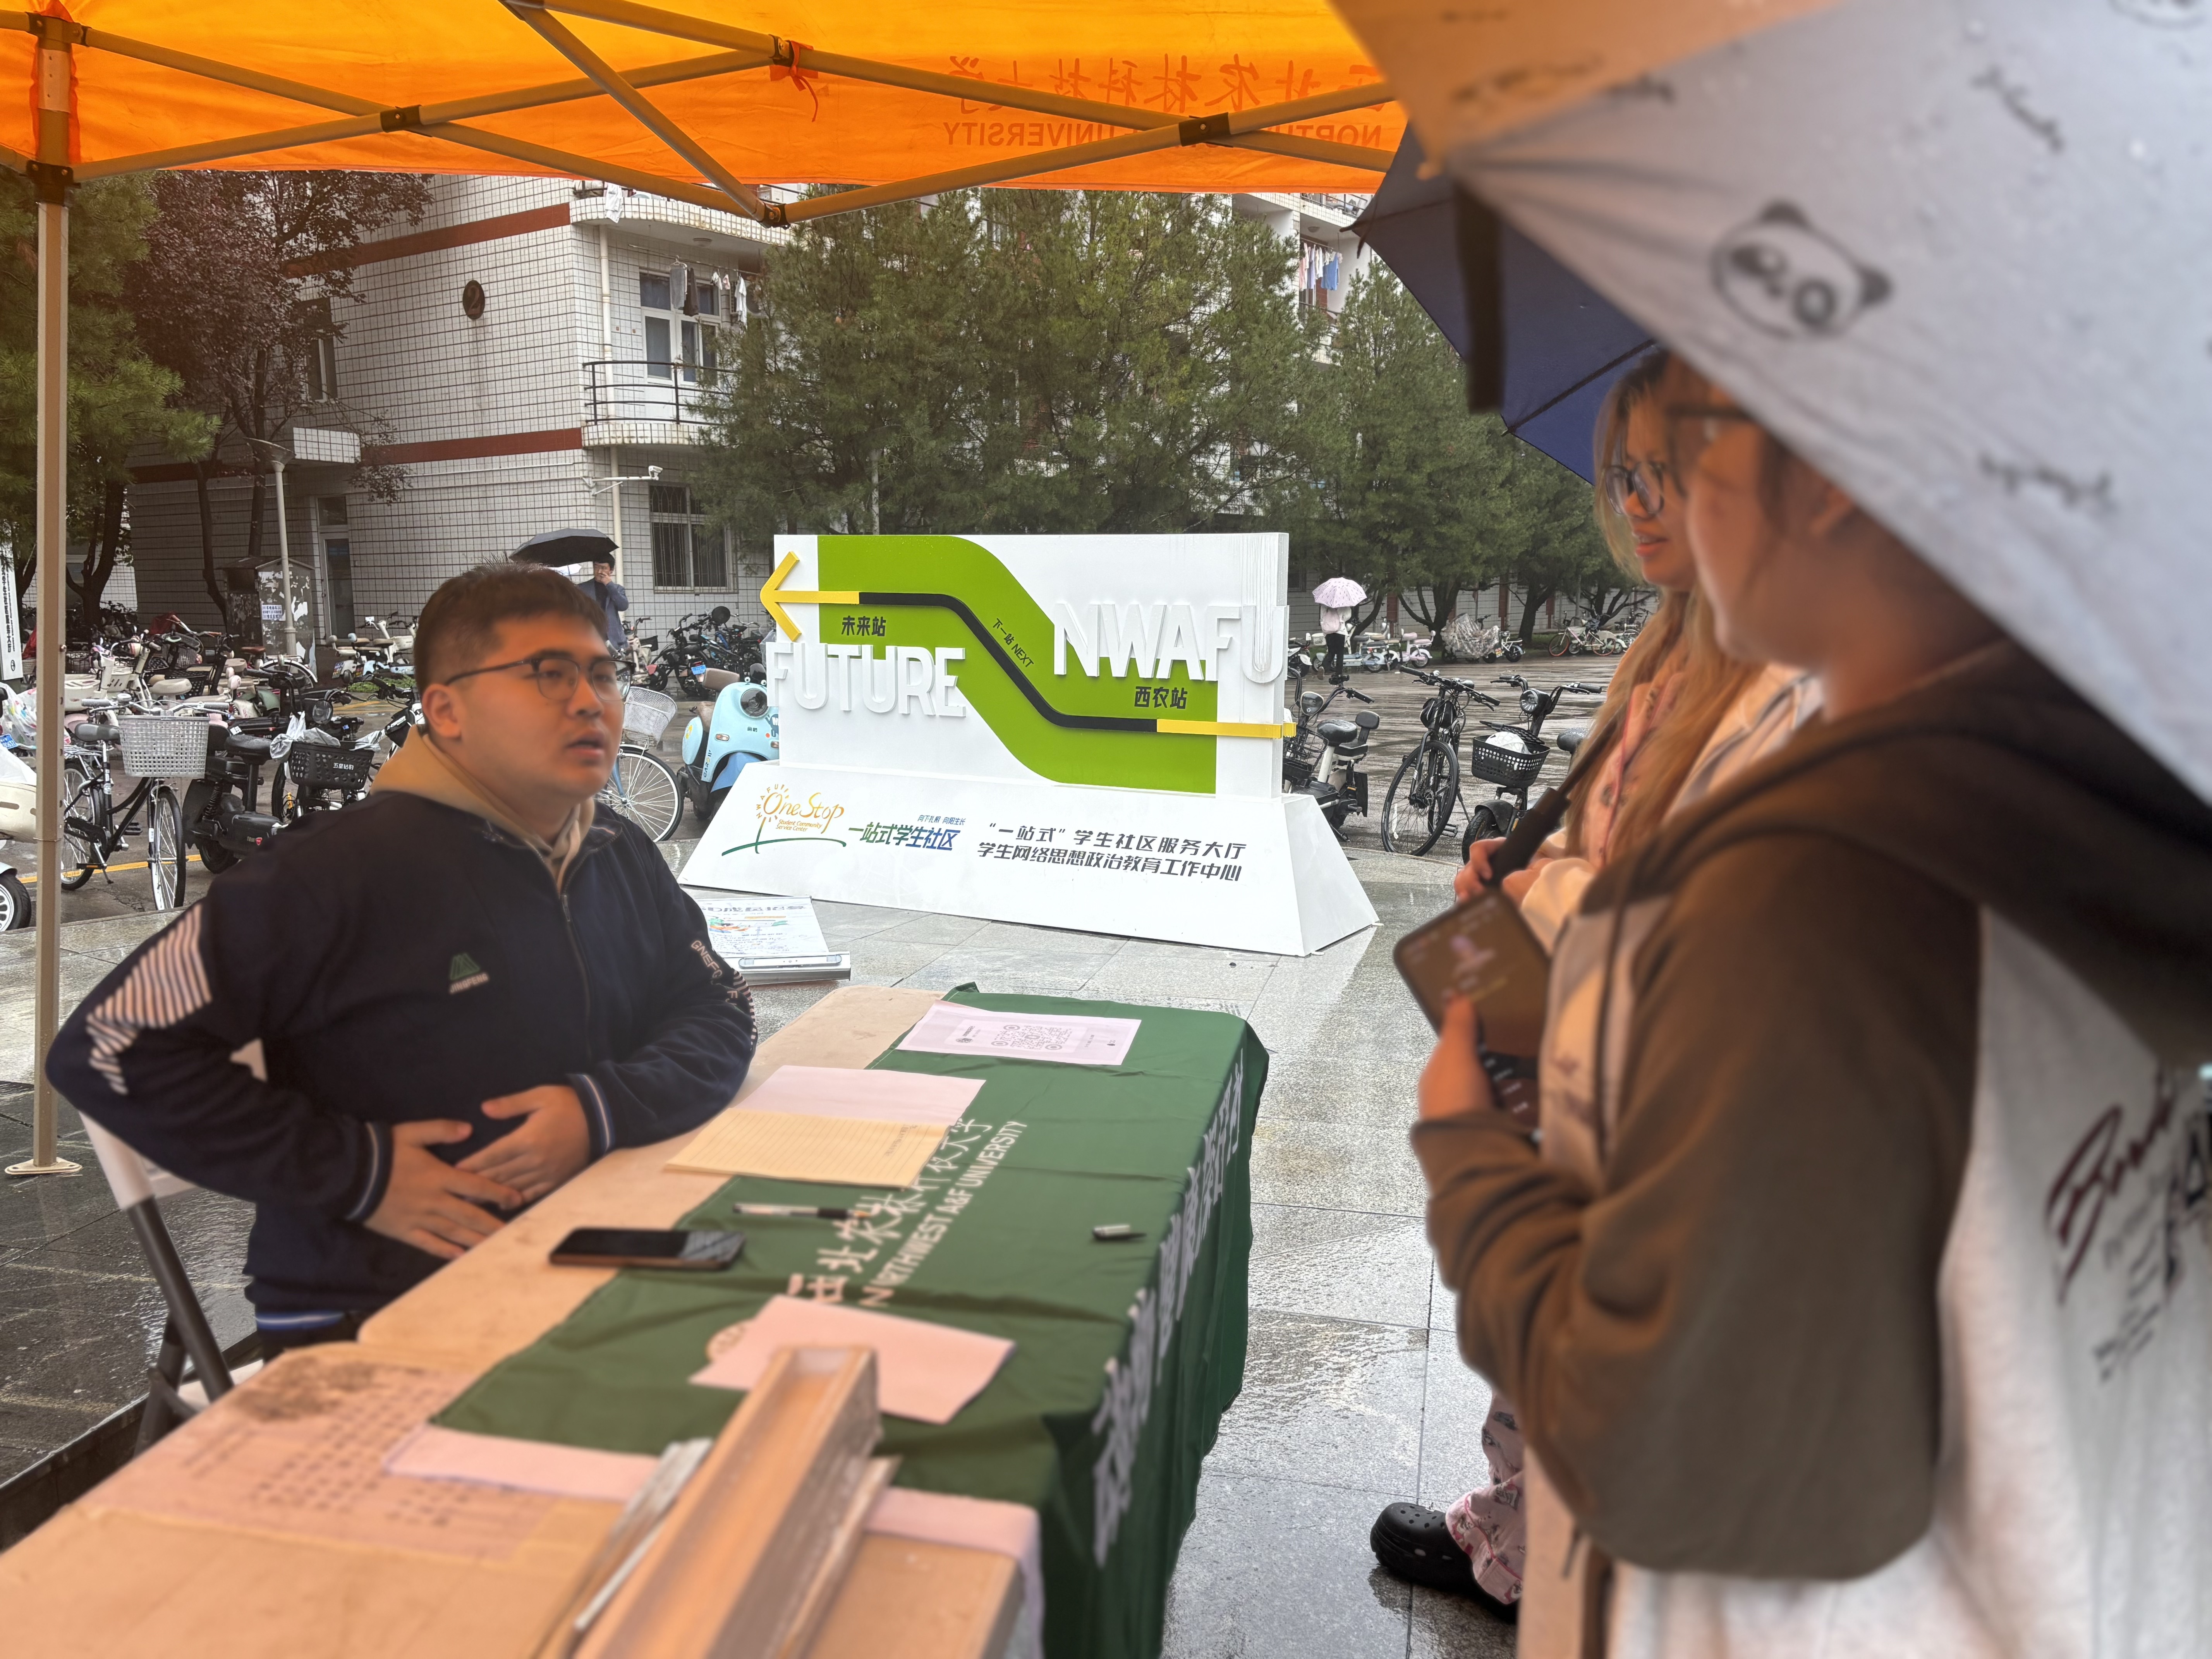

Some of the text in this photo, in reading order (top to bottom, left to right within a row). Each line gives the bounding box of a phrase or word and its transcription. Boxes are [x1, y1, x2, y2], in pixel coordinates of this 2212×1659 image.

[841, 616, 886, 636] 未来站
[993, 618, 1034, 667] 下一站 NEXT
[1054, 603, 1289, 683] NWAFU
[766, 641, 966, 717] FUTURE
[1134, 686, 1188, 709] 西农站
[797, 821, 823, 829] Community
[848, 822, 961, 851] 一站式学生社区
[977, 842, 1242, 881] 学生网络思想政治教育工作中心
[955, 1120, 1028, 1188] UNIVERSITY
